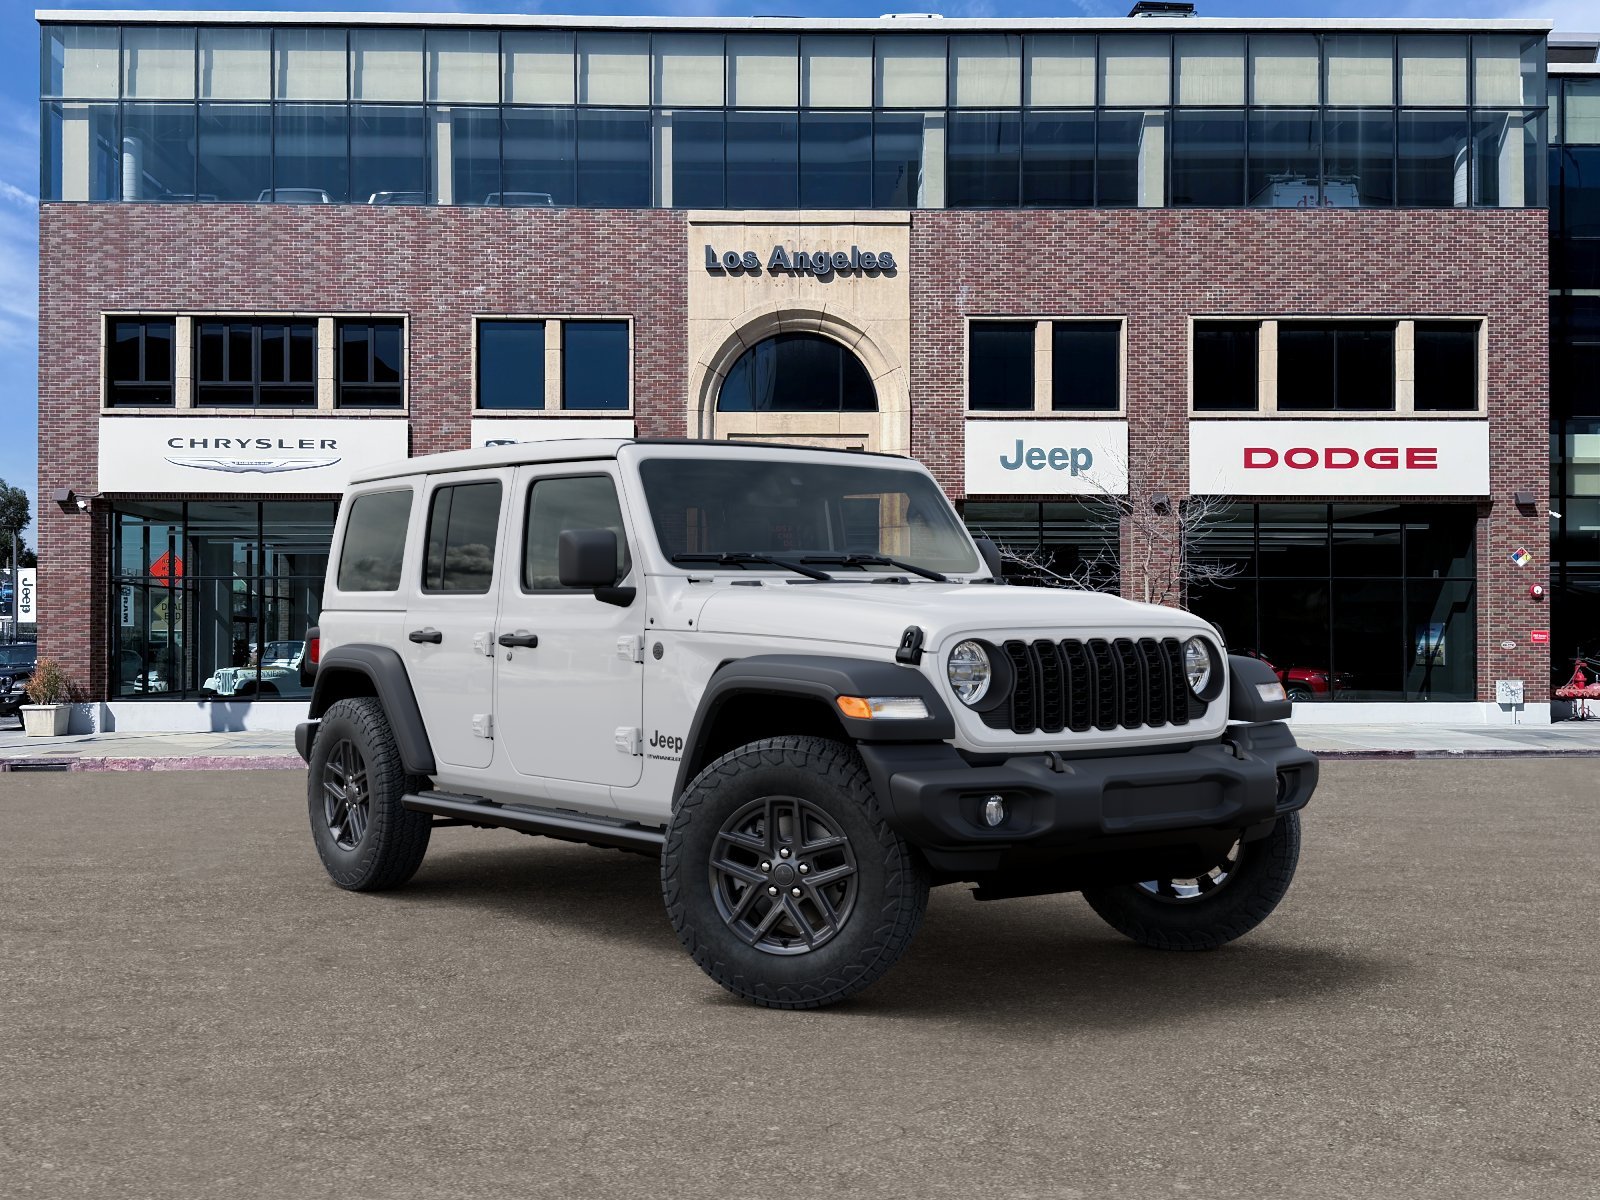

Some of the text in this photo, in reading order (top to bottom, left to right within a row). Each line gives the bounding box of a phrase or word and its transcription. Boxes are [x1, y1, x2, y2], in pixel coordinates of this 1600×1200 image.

[704, 244, 895, 275] Los Angeles
[167, 438, 337, 449] CHRYSLER
[1000, 439, 1093, 476] Jeep
[1243, 447, 1438, 469] DODGE
[19, 577, 34, 613] Jeep
[650, 729, 683, 753] Jeep
